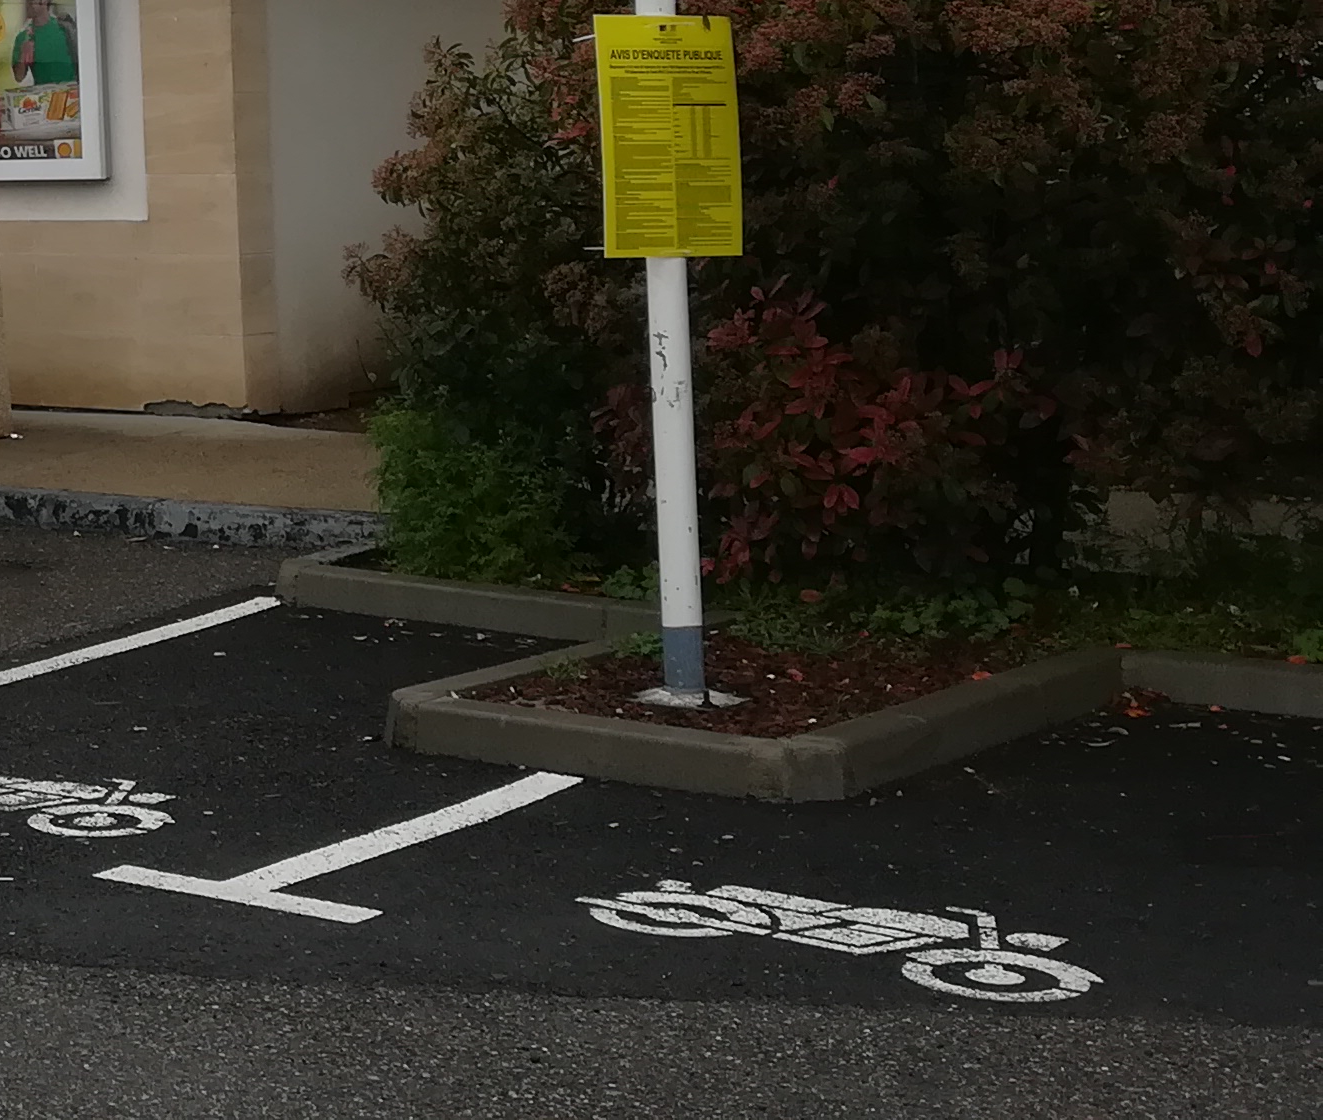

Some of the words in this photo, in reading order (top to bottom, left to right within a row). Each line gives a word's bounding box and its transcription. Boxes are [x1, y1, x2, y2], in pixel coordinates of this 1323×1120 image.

[610, 49, 631, 60] AVIS
[683, 50, 723, 60] PUBLIQUE
[14, 145, 47, 158] WELL
